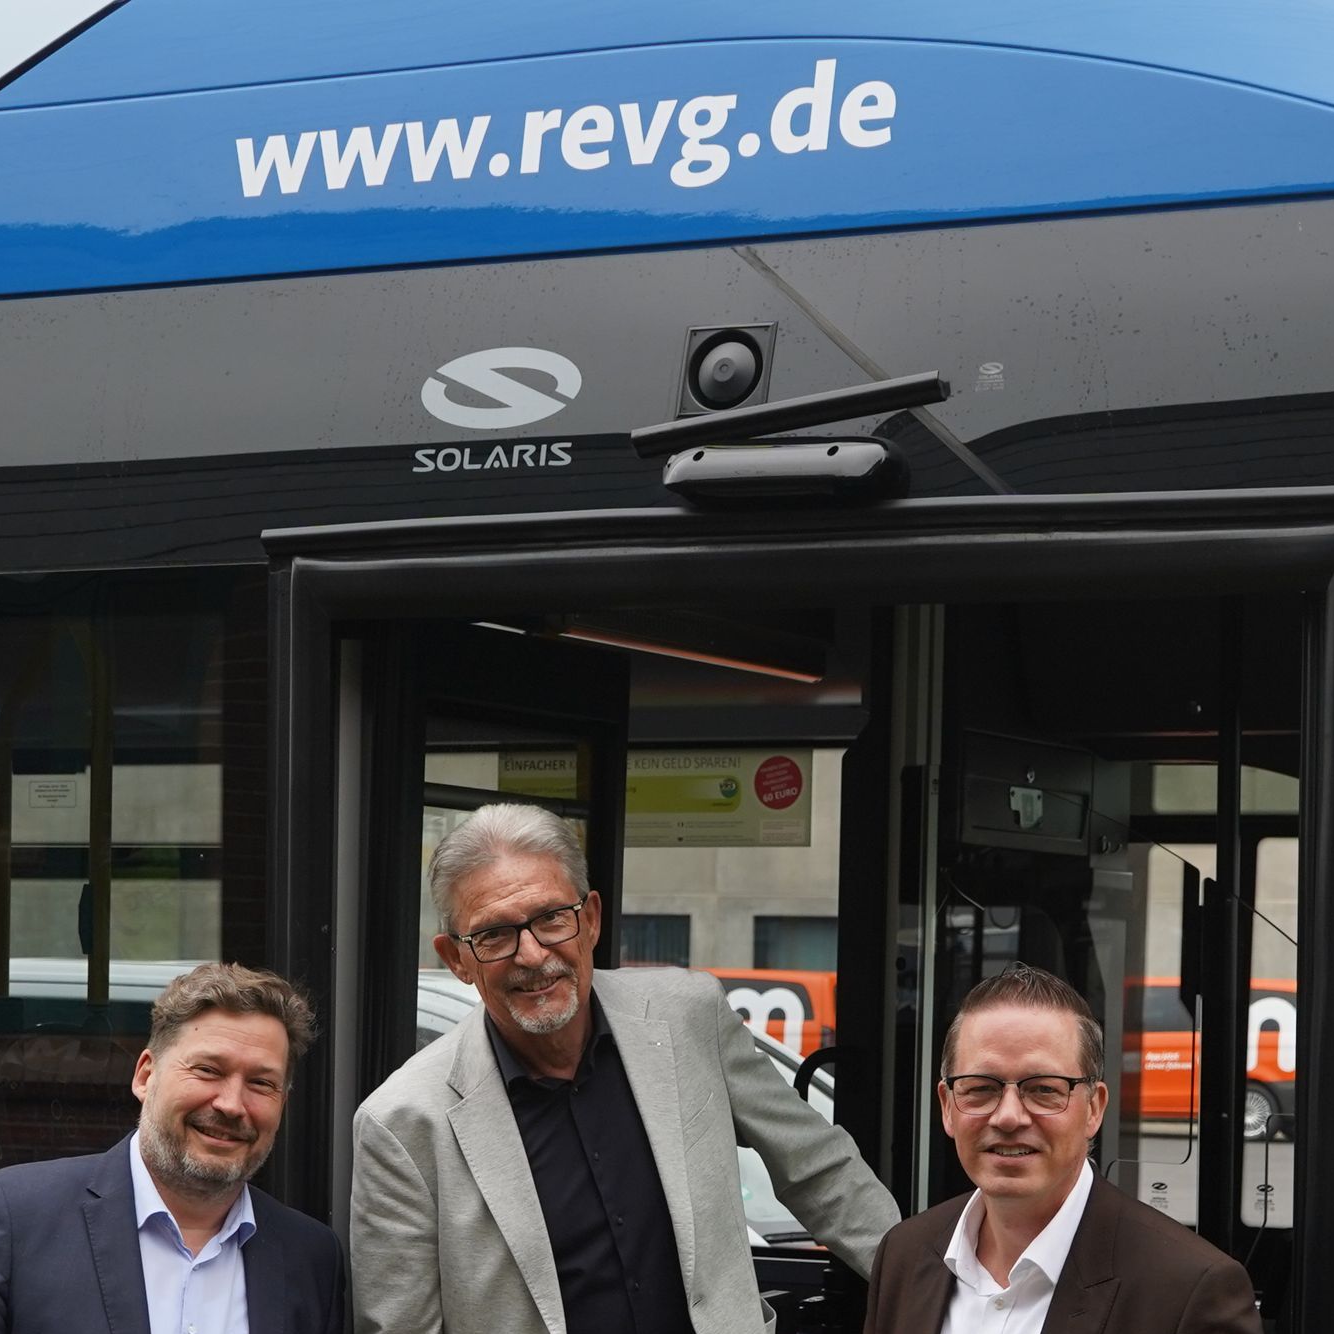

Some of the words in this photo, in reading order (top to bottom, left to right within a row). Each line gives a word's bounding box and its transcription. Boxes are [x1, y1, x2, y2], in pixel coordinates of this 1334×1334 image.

[235, 58, 897, 198] www.revg.de
[412, 441, 573, 473] SOLARIS
[634, 757, 662, 770] KEIN
[663, 757, 692, 770] GELD
[693, 756, 742, 770] SPAREN!
[774, 787, 798, 801] EURO
